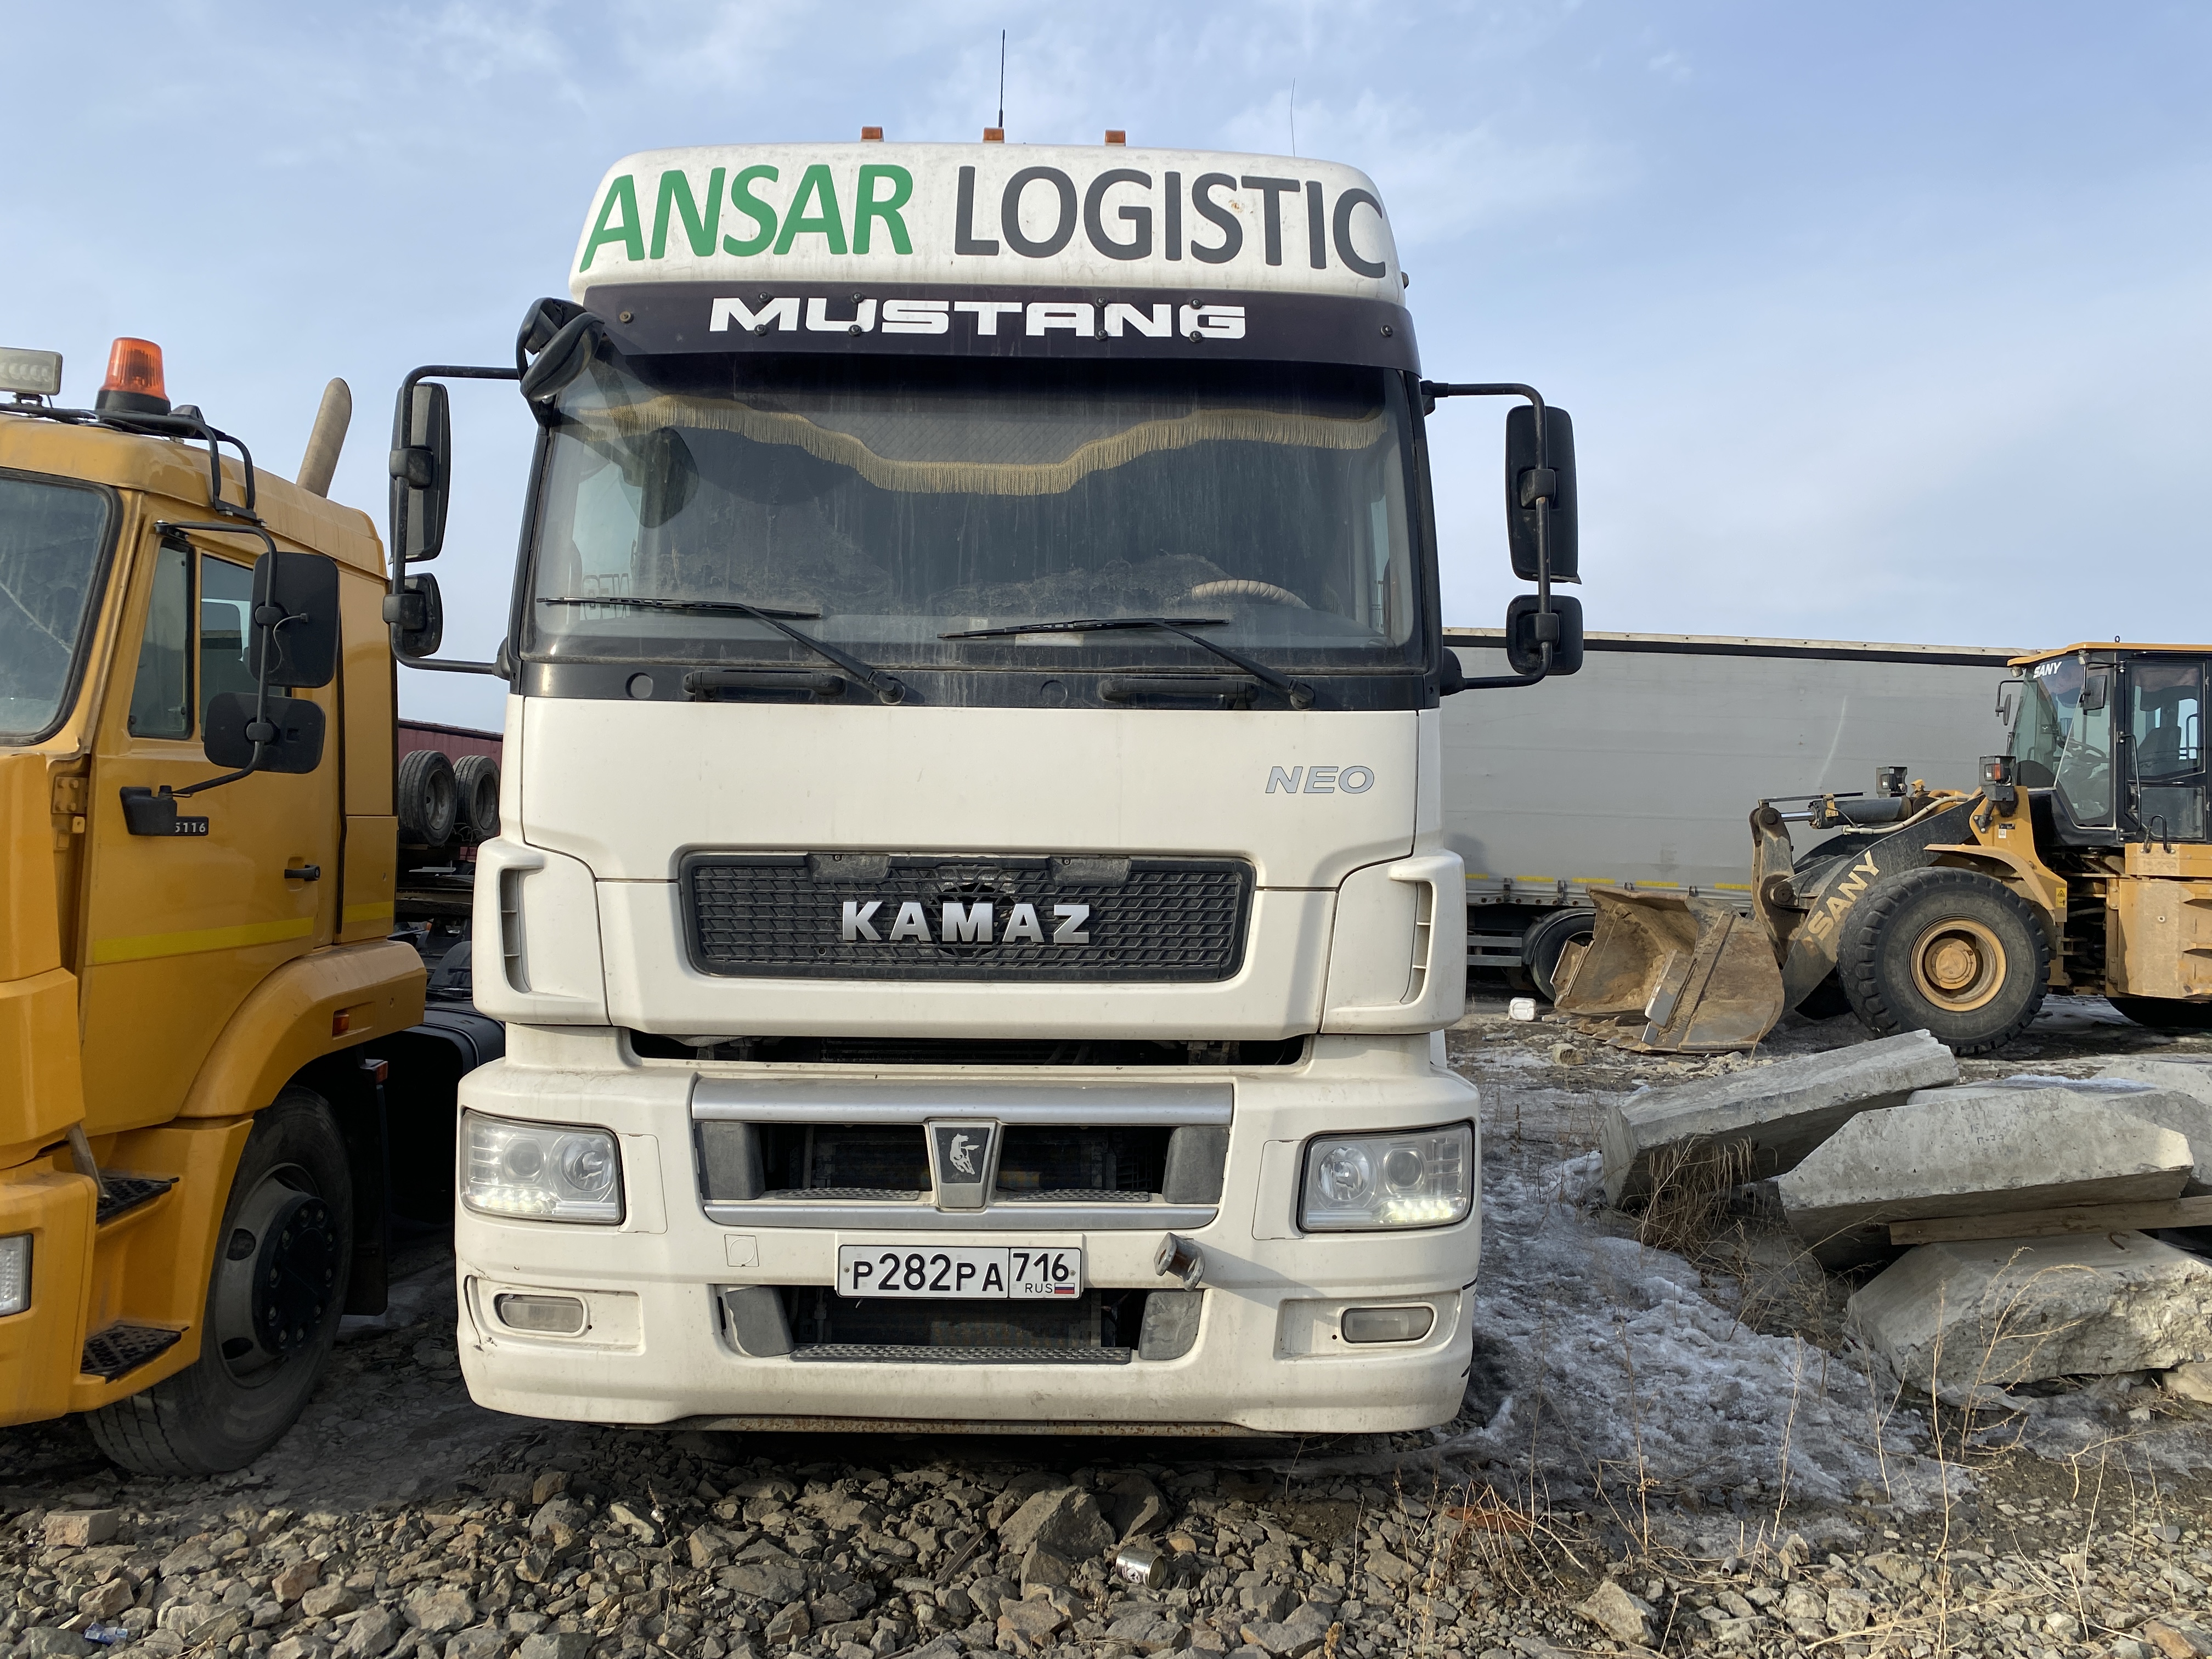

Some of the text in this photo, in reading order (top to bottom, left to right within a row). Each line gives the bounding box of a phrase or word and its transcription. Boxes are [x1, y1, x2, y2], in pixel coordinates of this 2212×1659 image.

[579, 164, 1386, 278] ANSAR LOGISTIC
[709, 297, 1245, 340] MUSTANG
[2033, 661, 2062, 679] SANY
[1265, 765, 1375, 794] NEO
[1808, 850, 1880, 940] SANY
[842, 899, 1090, 944] KAMAZ
[1012, 1252, 1069, 1282] 716
[1025, 1283, 1053, 1294] RUS
